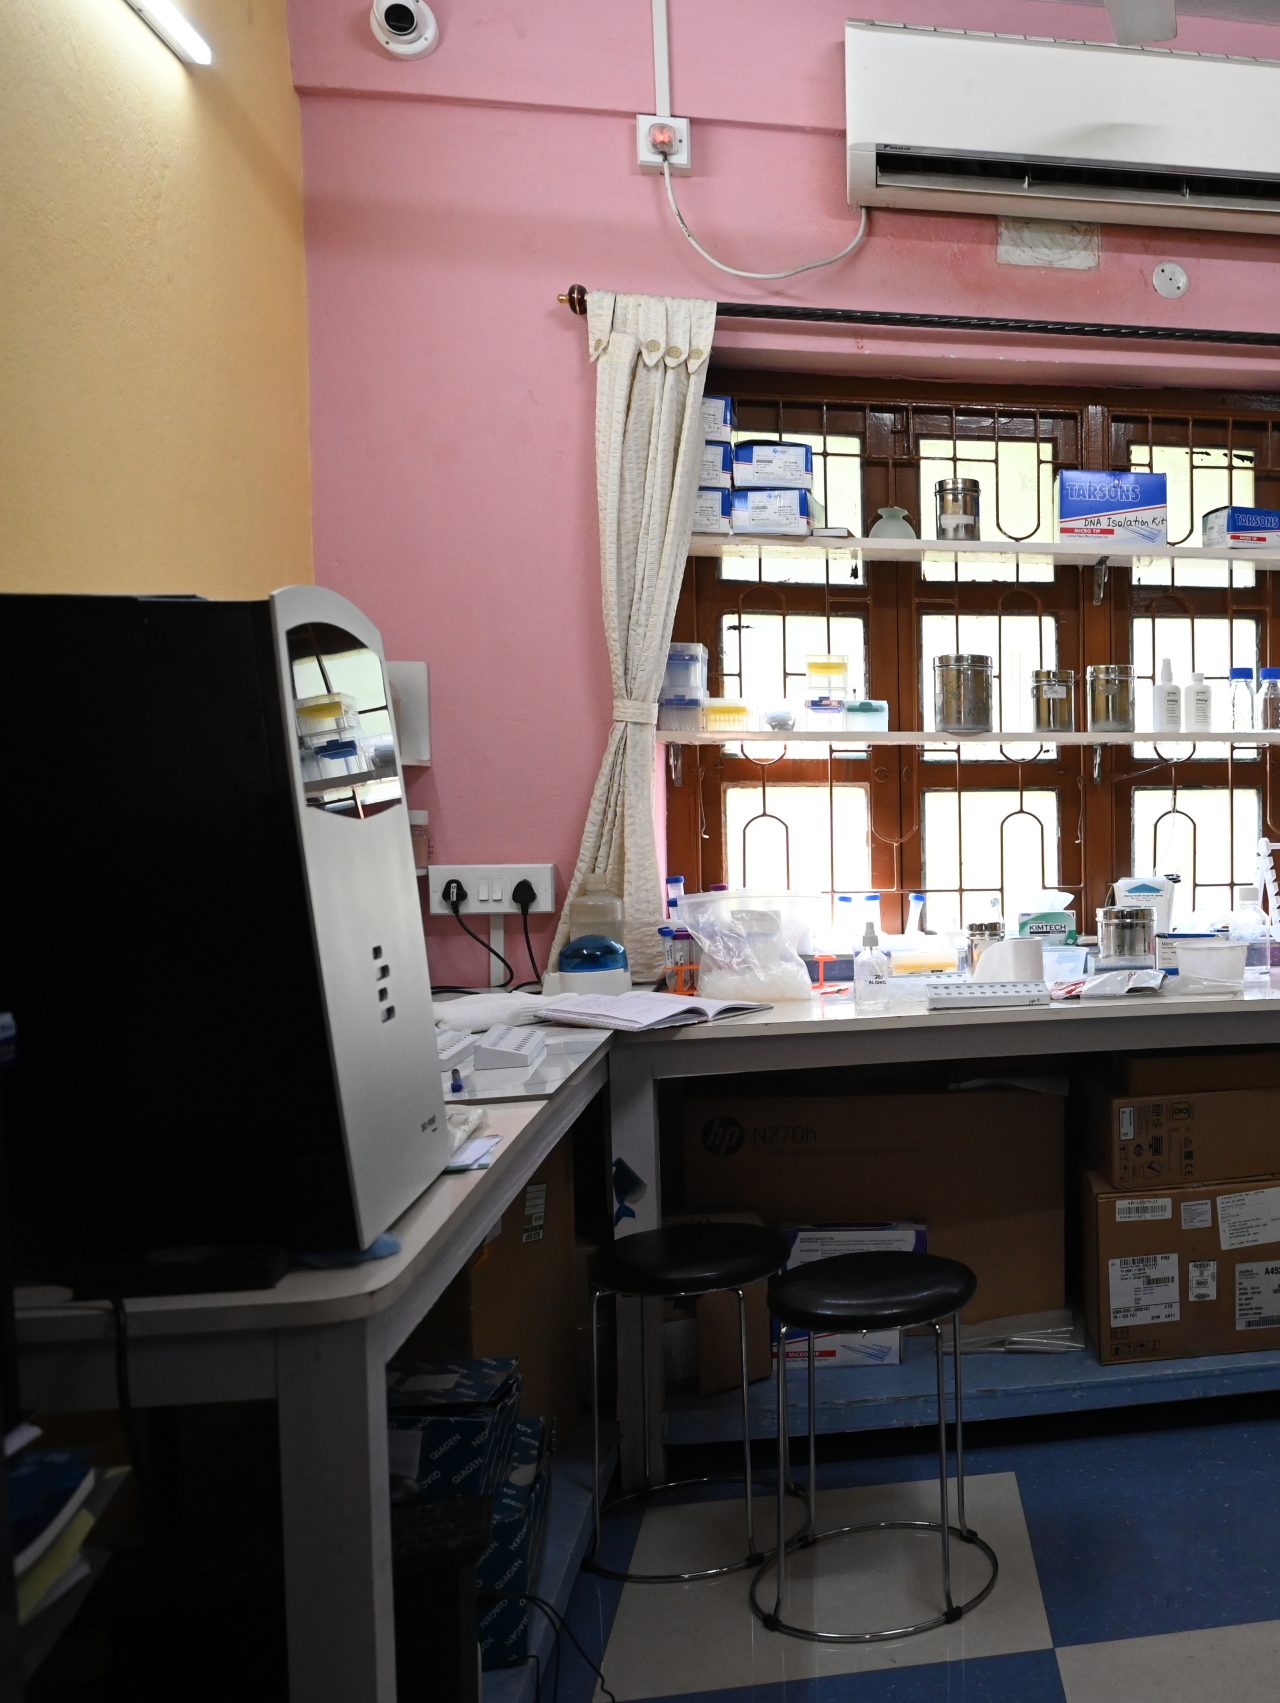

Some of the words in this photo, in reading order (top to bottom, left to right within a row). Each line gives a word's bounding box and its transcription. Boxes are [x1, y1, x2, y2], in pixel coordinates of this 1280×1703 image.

[1066, 482, 1141, 503] TARSONS
[1084, 518, 1101, 527] DNA
[1107, 518, 1149, 528] Isolation
[1151, 515, 1167, 526] Kit
[1235, 513, 1280, 528] TARSONS
[706, 1118, 741, 1157] hp
[753, 1126, 817, 1145] N270h
[429, 1432, 463, 1461] QIAGEN
[494, 1558, 523, 1590] QIAGEN
